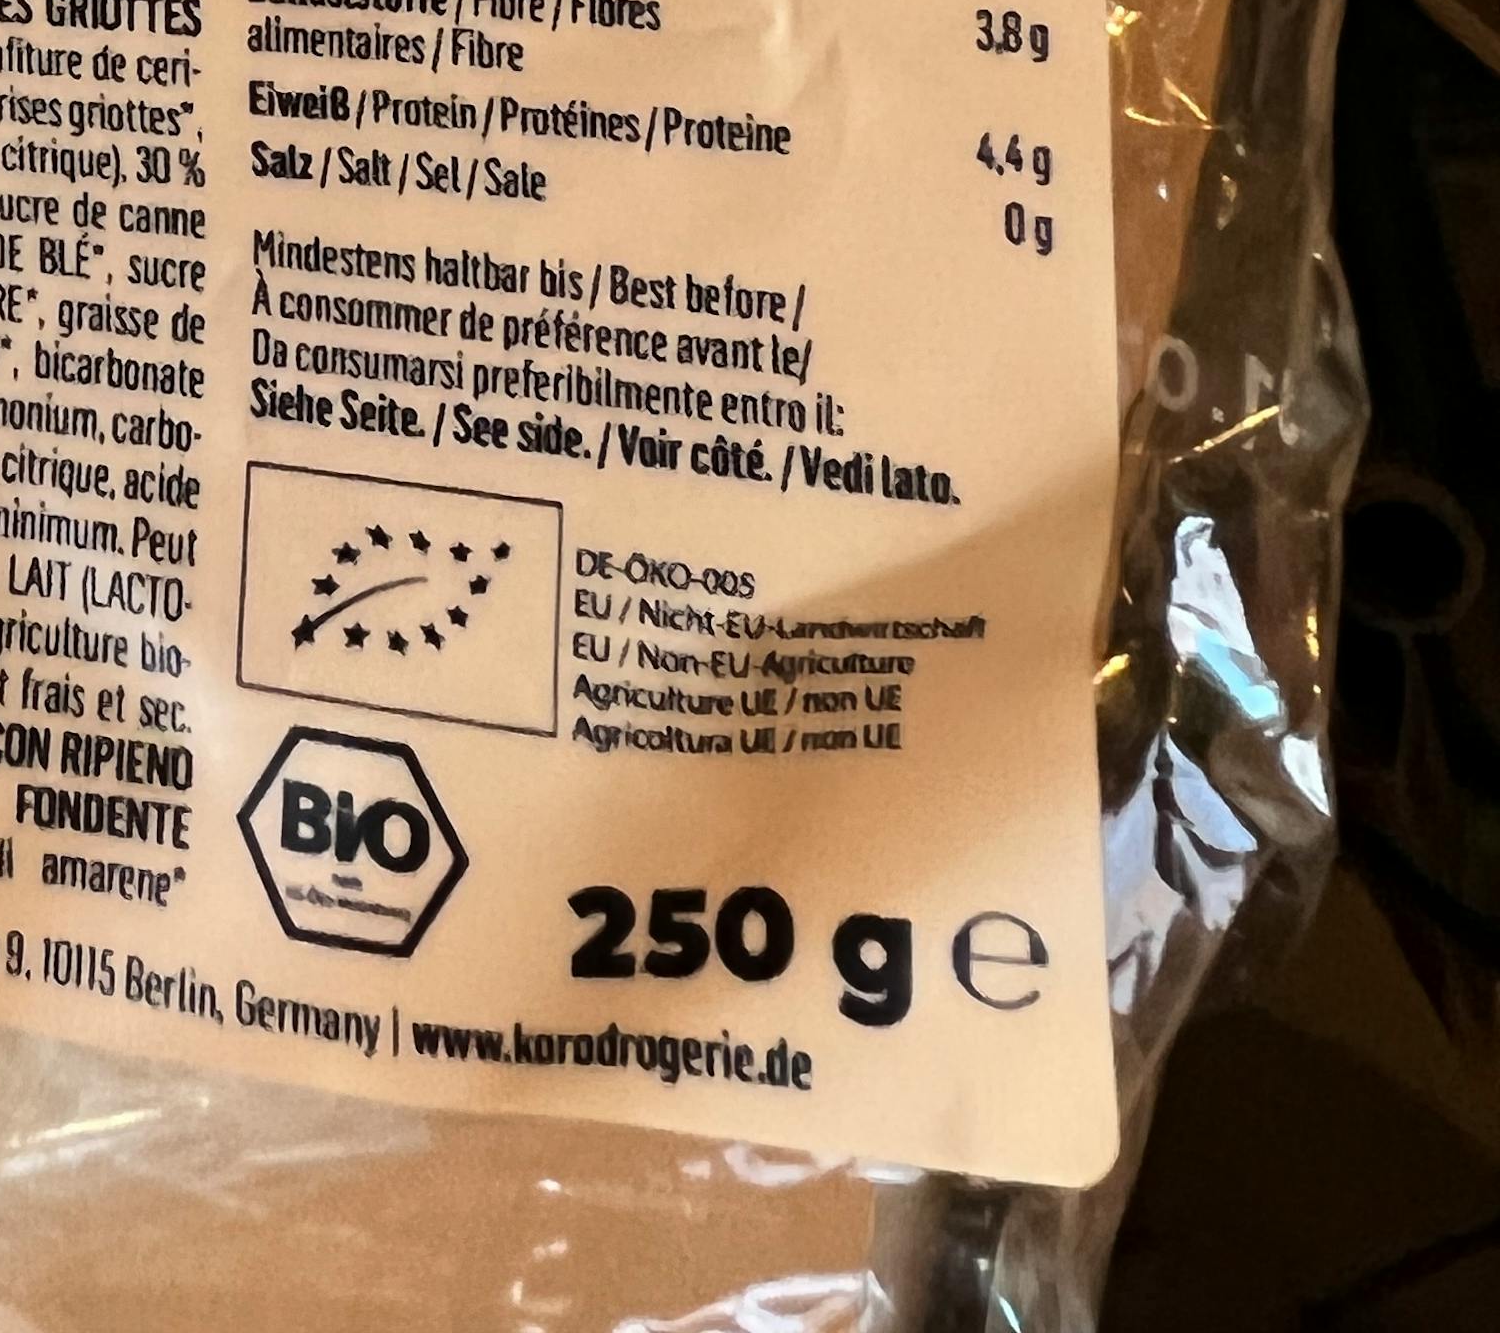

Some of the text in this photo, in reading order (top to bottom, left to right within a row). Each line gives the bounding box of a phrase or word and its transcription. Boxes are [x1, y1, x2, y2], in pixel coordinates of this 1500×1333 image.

[1028, 23, 1050, 63] g
[248, 79, 792, 156] Eiweiß Protein Protéines Proteine
[250, 139, 547, 203] Salz Salt Sel Sale
[1032, 145, 1052, 186] g
[1004, 201, 1054, 257] 0 g
[249, 378, 334, 428] Siehe
[452, 402, 509, 450] See
[617, 422, 683, 471] Voir
[798, 444, 875, 496] Vedi
[880, 454, 962, 506] lato.
[60, 730, 194, 790] RIPIENO
[15, 783, 193, 851] FONDENTE
[566, 885, 796, 983] 250
[831, 912, 913, 1028] g
[43, 936, 116, 997] 10115
[124, 954, 224, 1026] Berlin,
[235, 979, 381, 1059] Germany
[411, 1021, 813, 1091] www.korodrogerie.de
